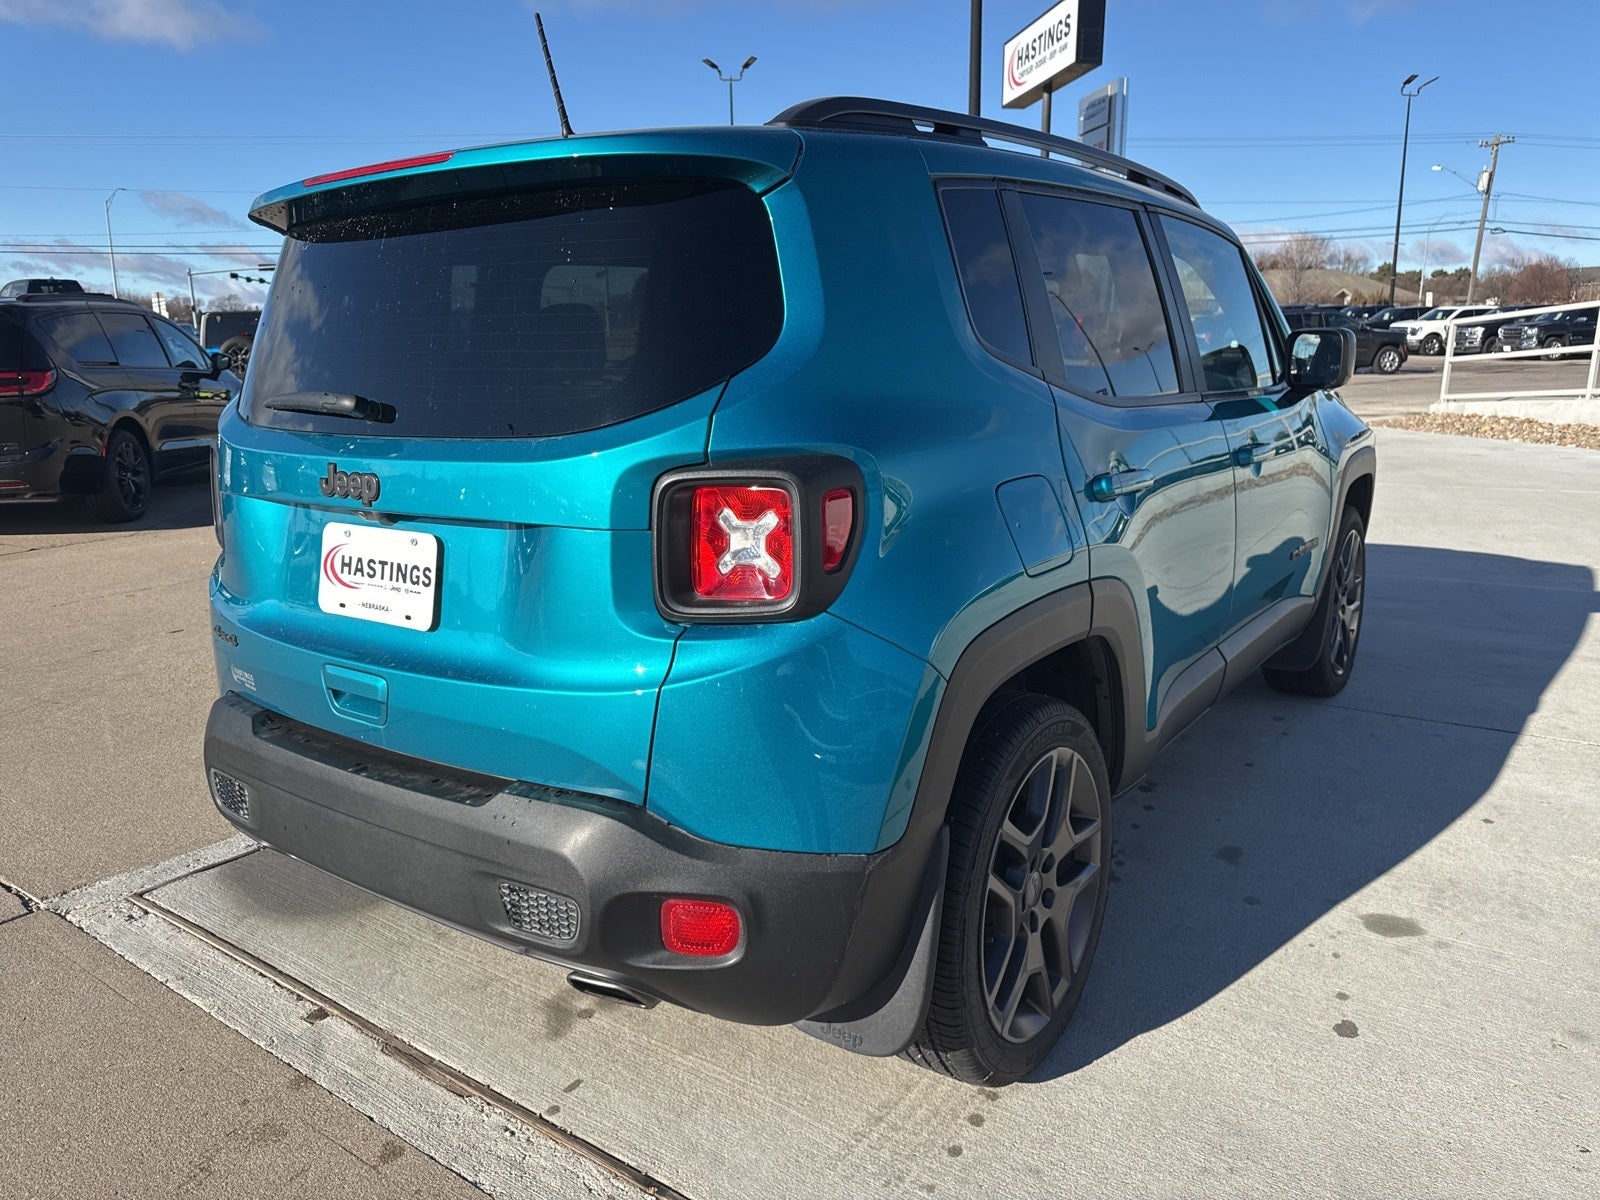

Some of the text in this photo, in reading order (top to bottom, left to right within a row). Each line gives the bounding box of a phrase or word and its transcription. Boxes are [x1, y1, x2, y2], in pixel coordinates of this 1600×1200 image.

[1016, 13, 1071, 70] HASTINGS
[320, 462, 380, 507] Jeep
[340, 555, 432, 588] HASTINGS
[390, 585, 401, 593] Jeep
[361, 602, 390, 612] NEBRASKA
[820, 1021, 863, 1048] Jeep
